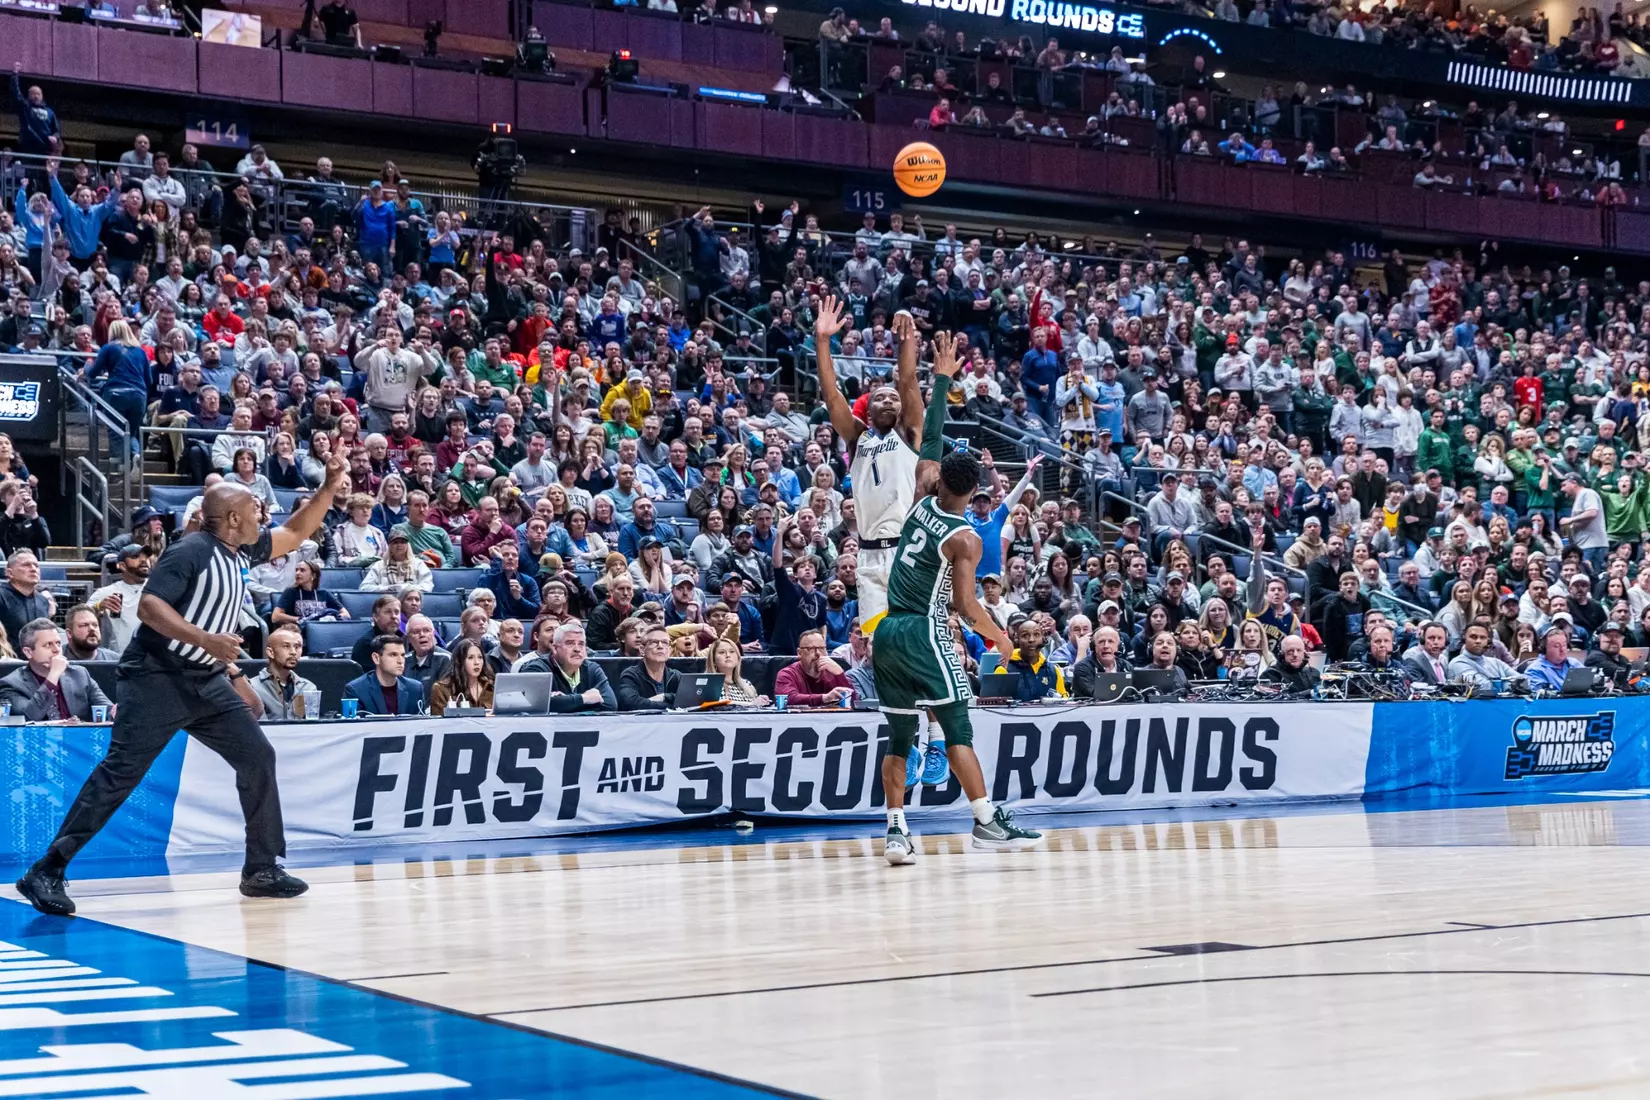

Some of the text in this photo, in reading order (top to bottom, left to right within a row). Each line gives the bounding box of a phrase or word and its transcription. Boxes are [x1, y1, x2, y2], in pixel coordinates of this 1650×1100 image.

[1011, 2, 1115, 34] ROUNDS
[197, 120, 239, 142] 114
[914, 174, 938, 183] NCAA
[853, 190, 885, 209] 115
[1351, 241, 1376, 259] 116
[1527, 387, 1537, 402] 3
[857, 438, 899, 459] Marquette
[871, 459, 881, 487] 1
[914, 503, 949, 538] WALKER
[900, 527, 927, 568] 2
[1531, 719, 1588, 743] MARCH
[1538, 741, 1613, 767] MADNESS
[353, 717, 1280, 832] FIRST AND SECO ROUNDS
